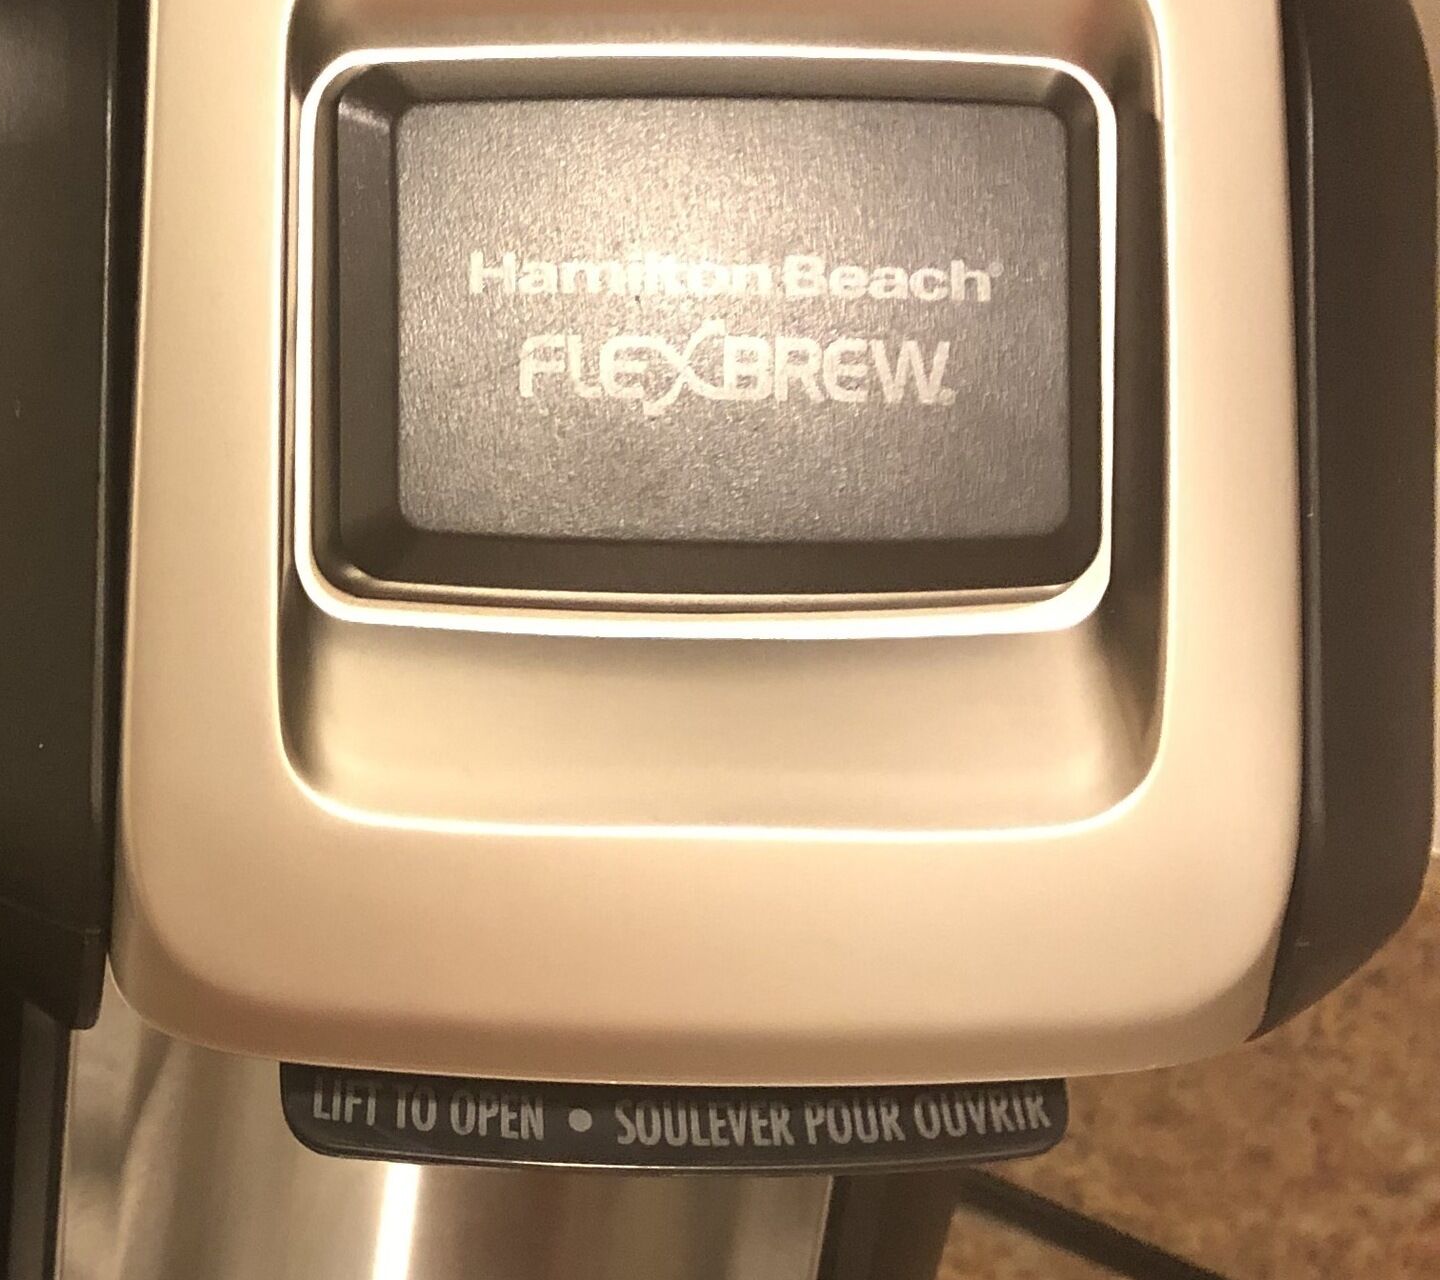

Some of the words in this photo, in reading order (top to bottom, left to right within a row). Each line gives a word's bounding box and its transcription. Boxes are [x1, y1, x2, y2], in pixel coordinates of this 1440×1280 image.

[469, 249, 773, 297] Hamilton
[312, 1075, 379, 1126] LIFT
[393, 1086, 438, 1132] TO
[450, 1091, 545, 1140] OPEN
[615, 1099, 794, 1147] SOULEVER
[806, 1097, 908, 1145] POUR
[914, 1089, 1053, 1138] OUVRIR
